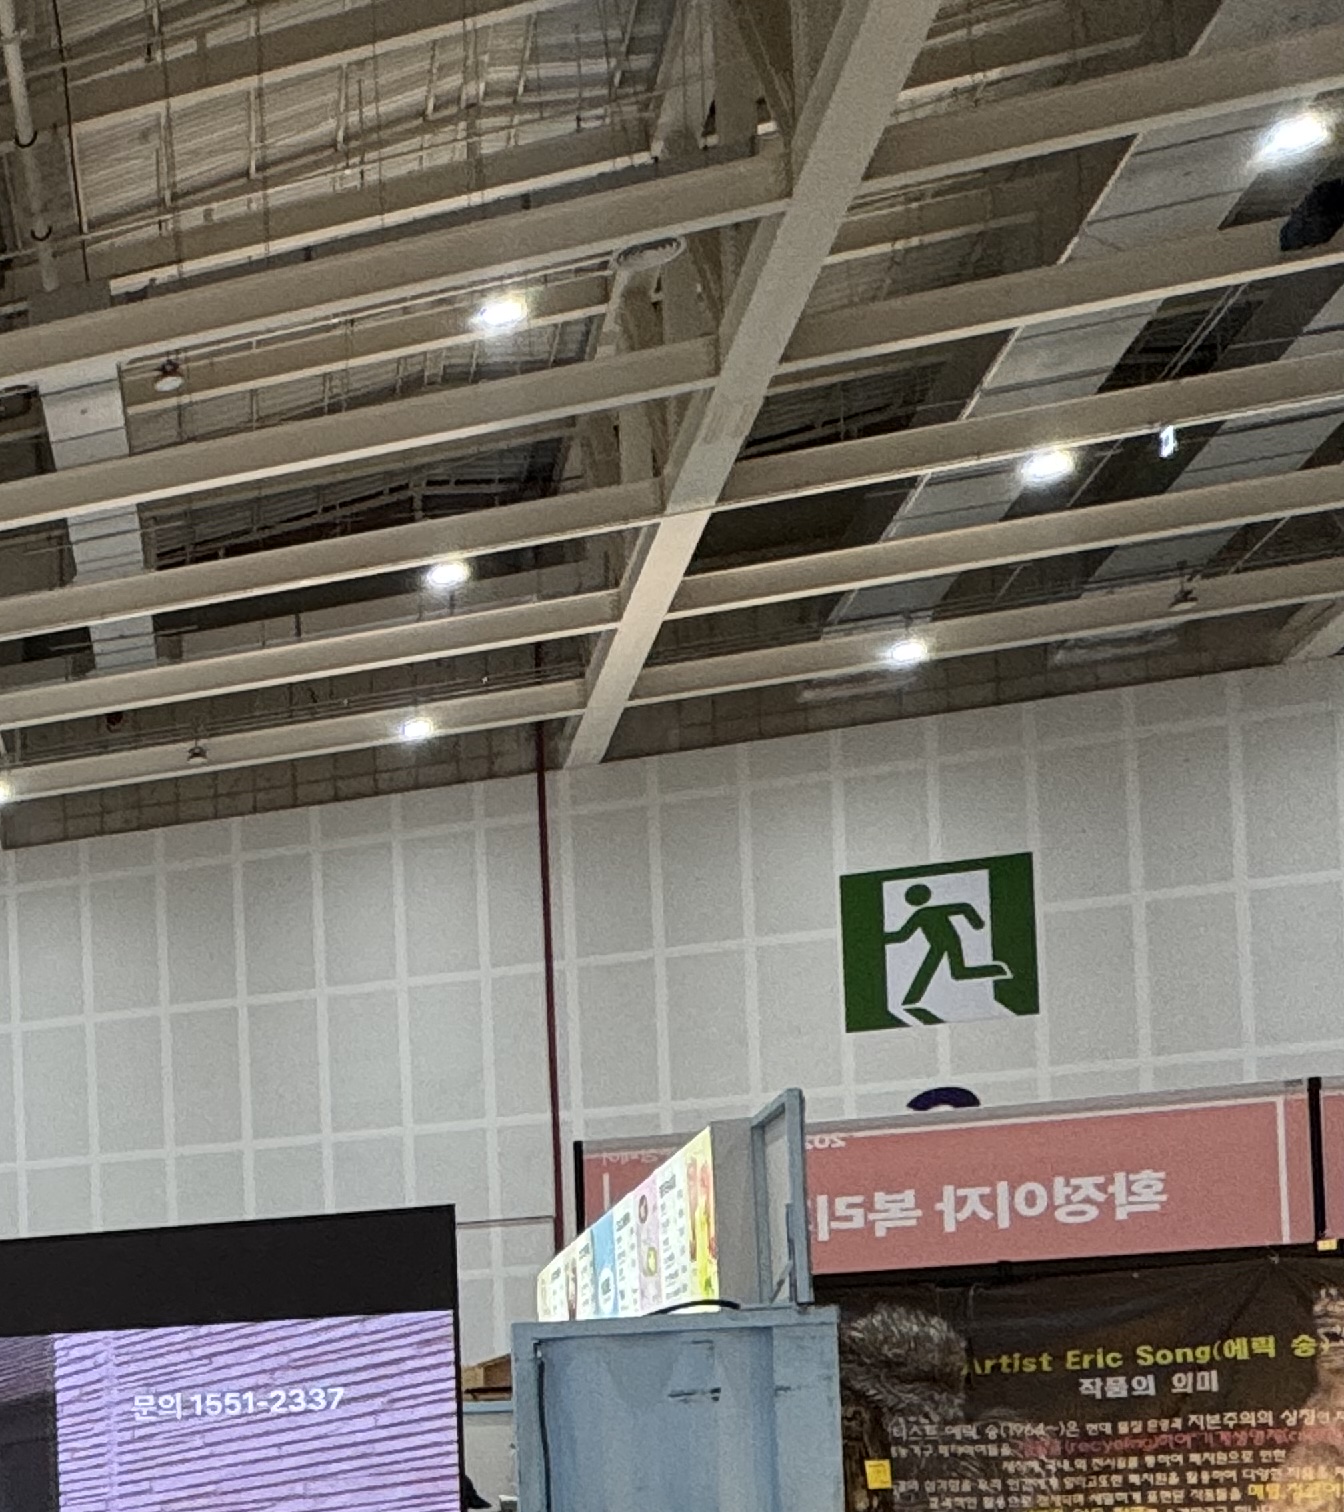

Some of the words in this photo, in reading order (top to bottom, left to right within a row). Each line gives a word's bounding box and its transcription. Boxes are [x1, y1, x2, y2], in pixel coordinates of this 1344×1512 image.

[1065, 1347, 1124, 1370] Eric
[1078, 1374, 1157, 1400] 작품의
[1170, 1369, 1220, 1395] 의미
[131, 1392, 183, 1420] 문의
[190, 1387, 345, 1416] 1551-2337
